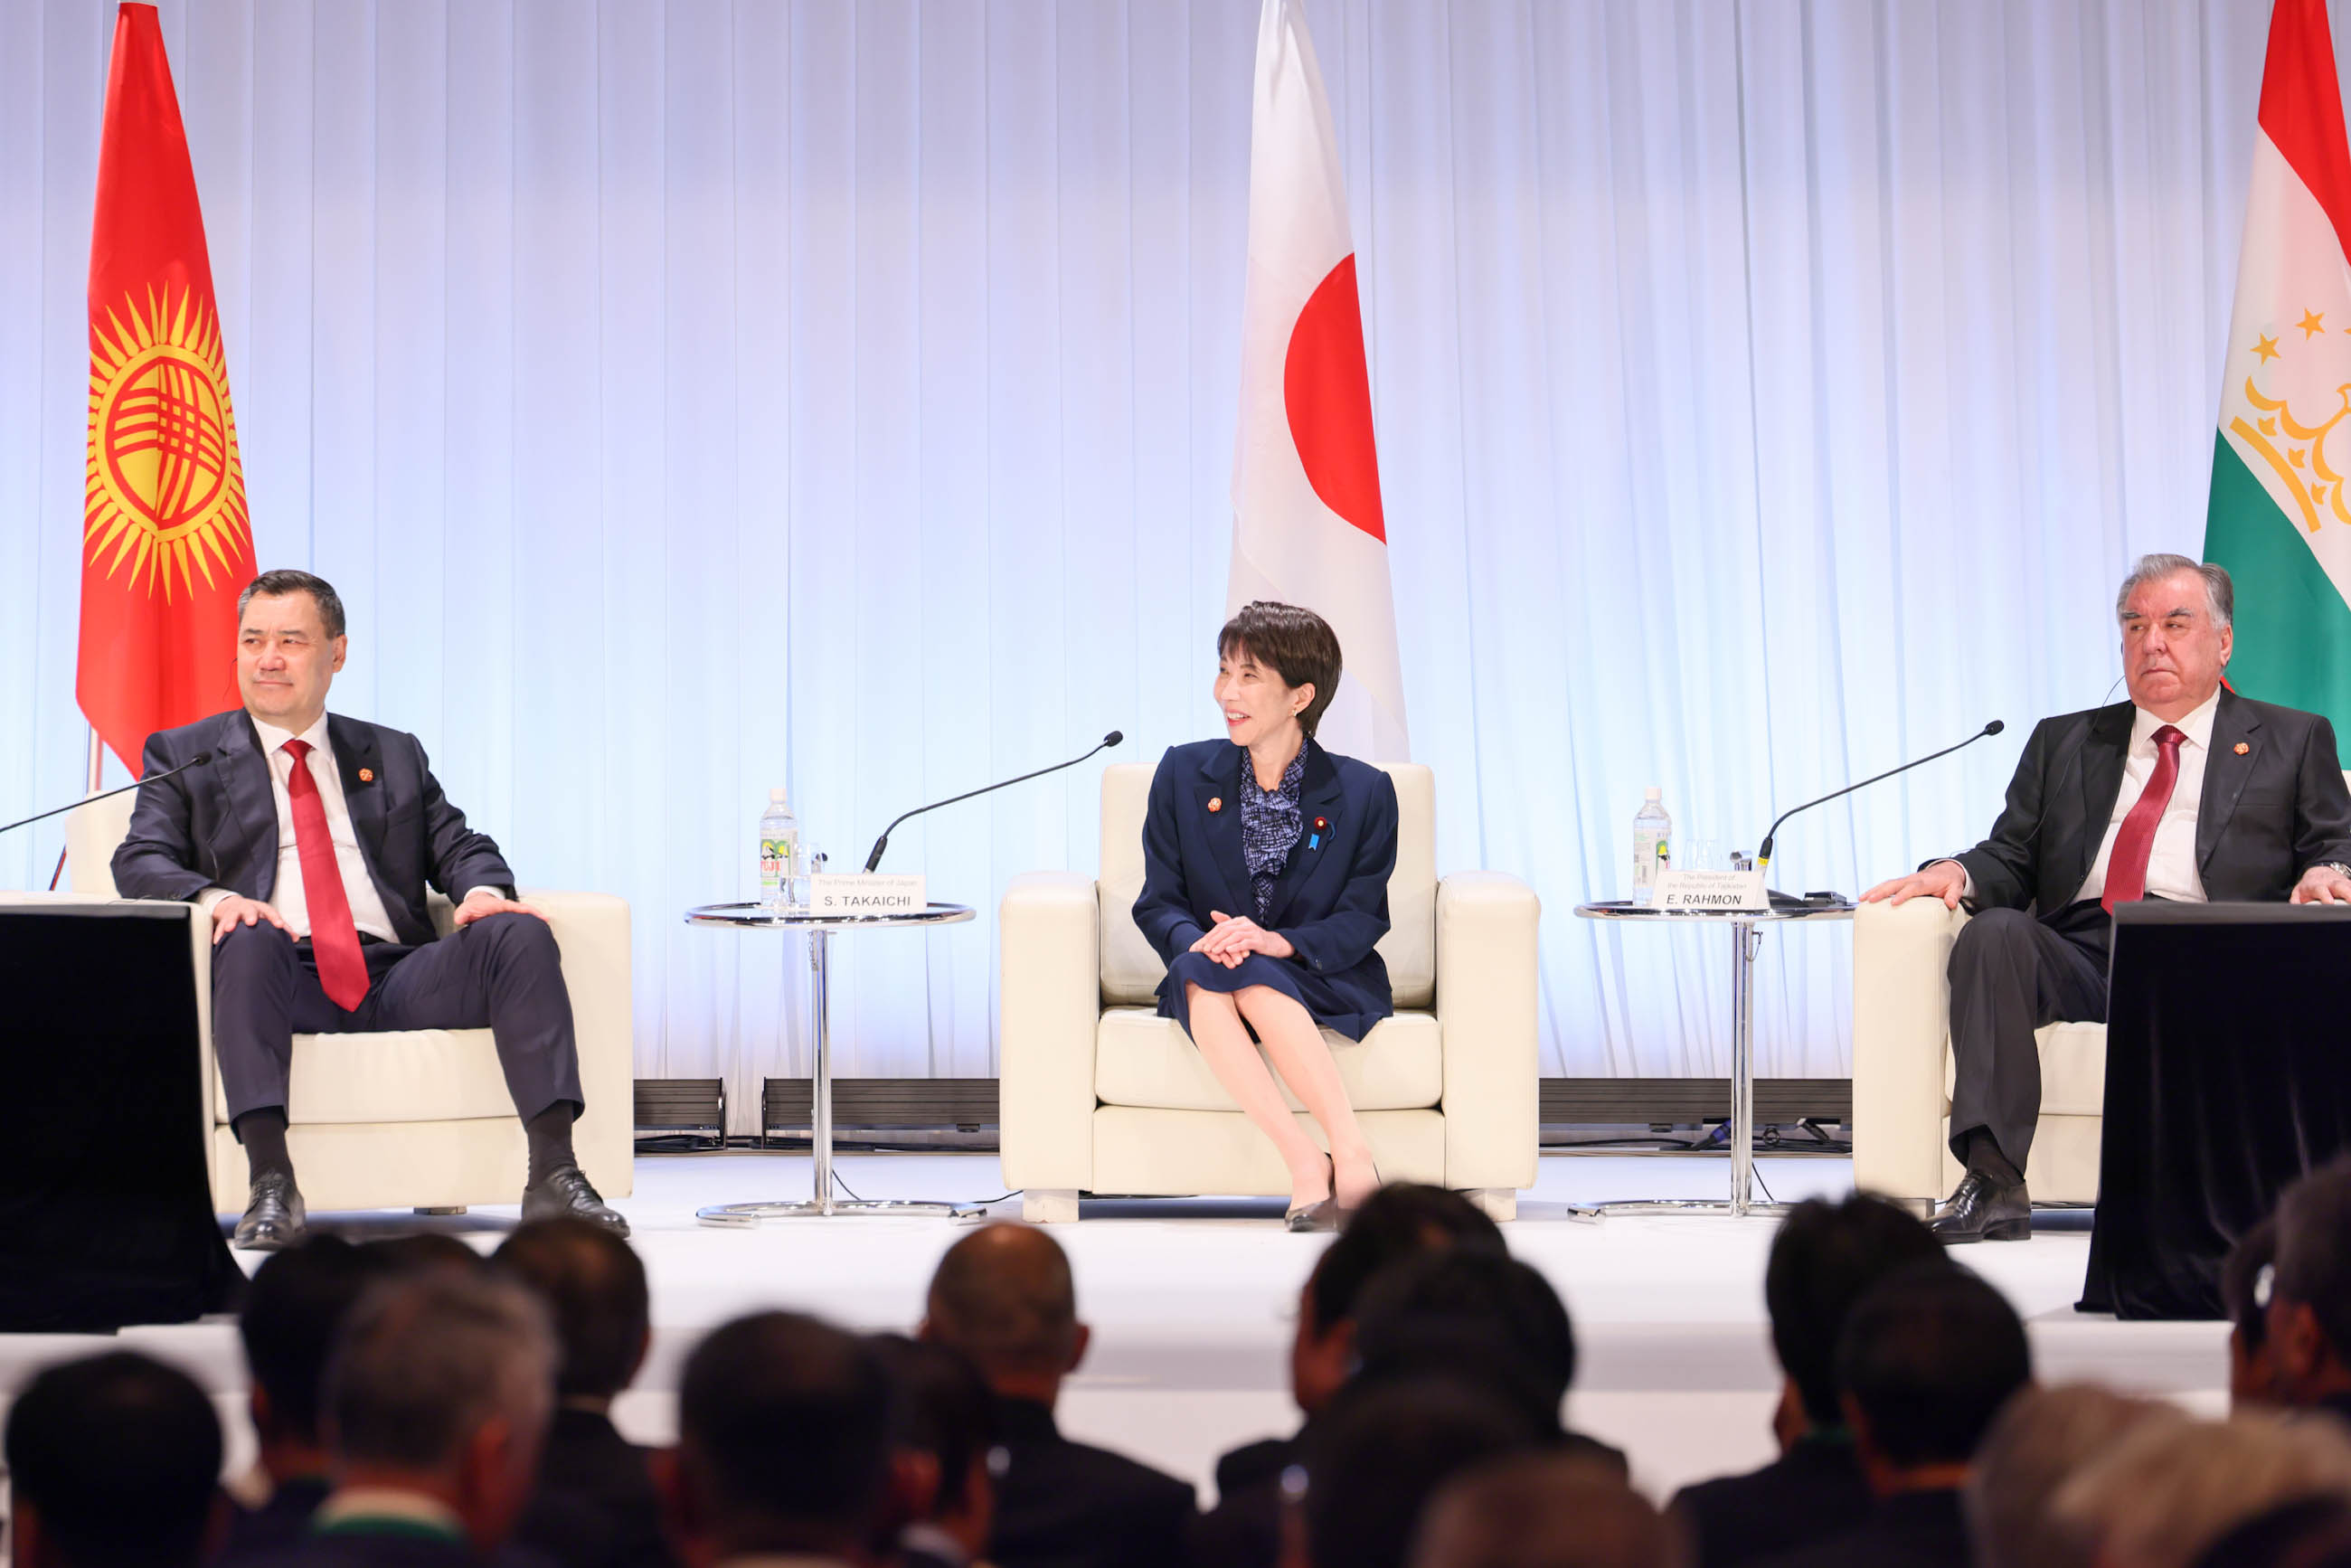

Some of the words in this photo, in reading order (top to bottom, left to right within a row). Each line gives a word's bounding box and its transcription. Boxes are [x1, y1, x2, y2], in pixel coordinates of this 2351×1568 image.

[824, 895, 837, 907] S.
[842, 895, 911, 907] TAKAICHI
[1666, 893, 1678, 904] E.
[1683, 893, 1742, 905] RAHMON
